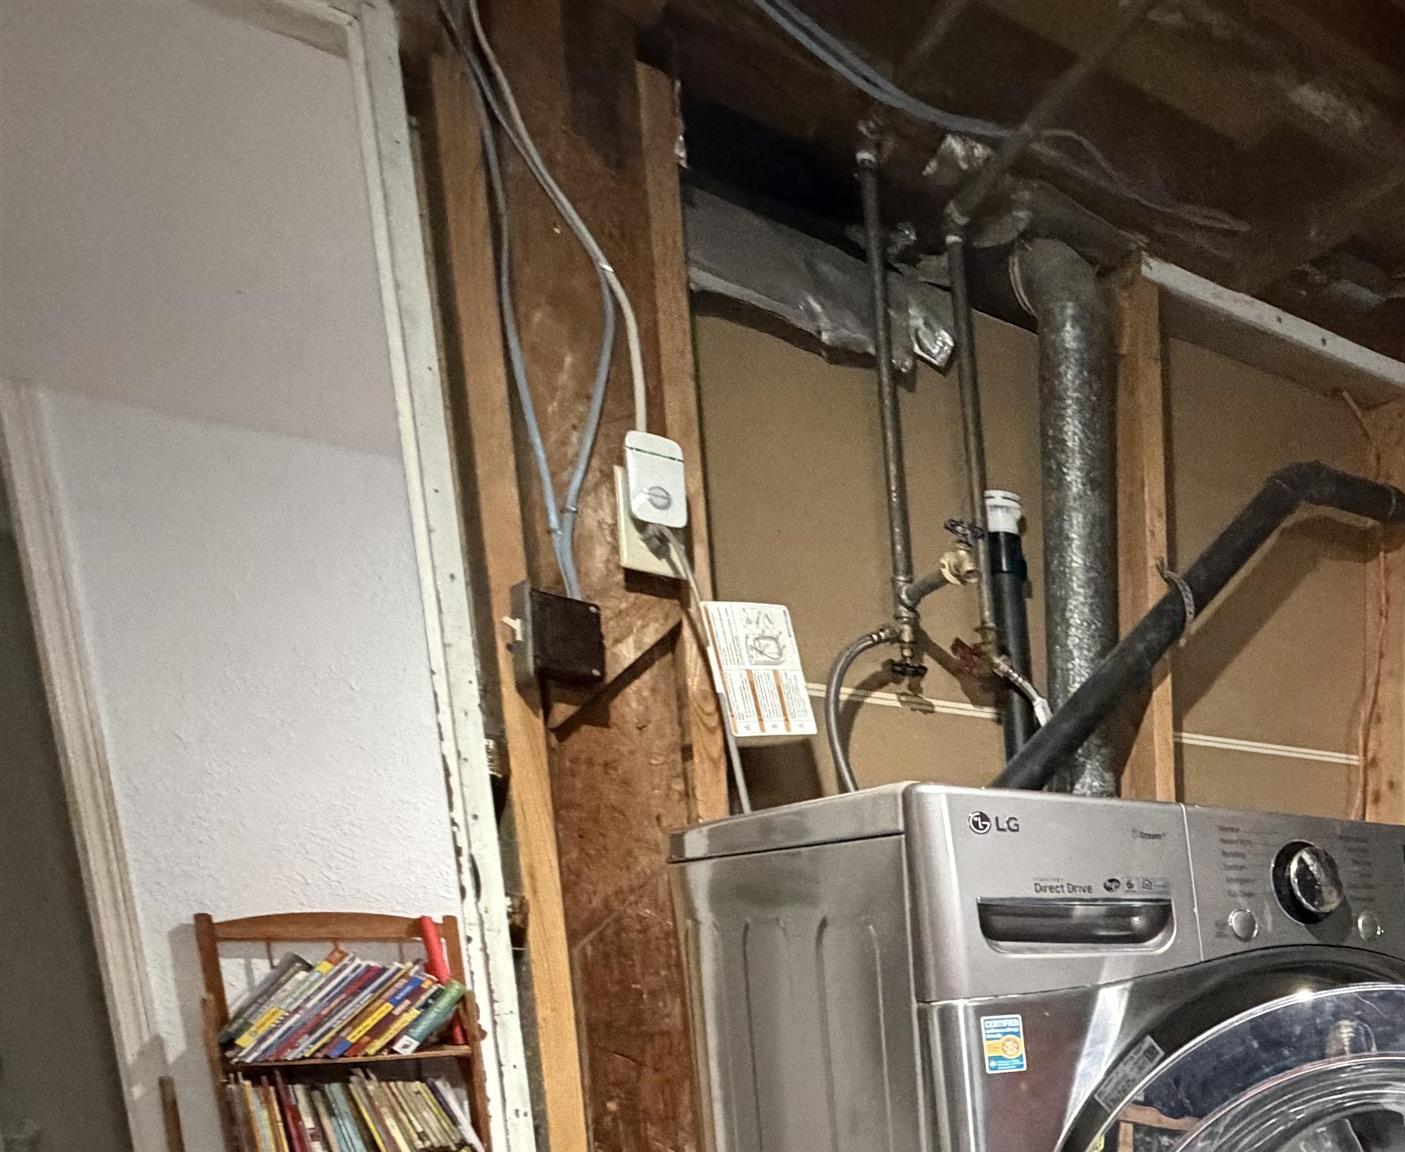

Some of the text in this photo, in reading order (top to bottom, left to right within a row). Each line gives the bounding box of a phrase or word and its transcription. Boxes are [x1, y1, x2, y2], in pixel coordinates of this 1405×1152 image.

[995, 816, 1020, 832] LG
[1034, 882, 1093, 894] Direct Drive
